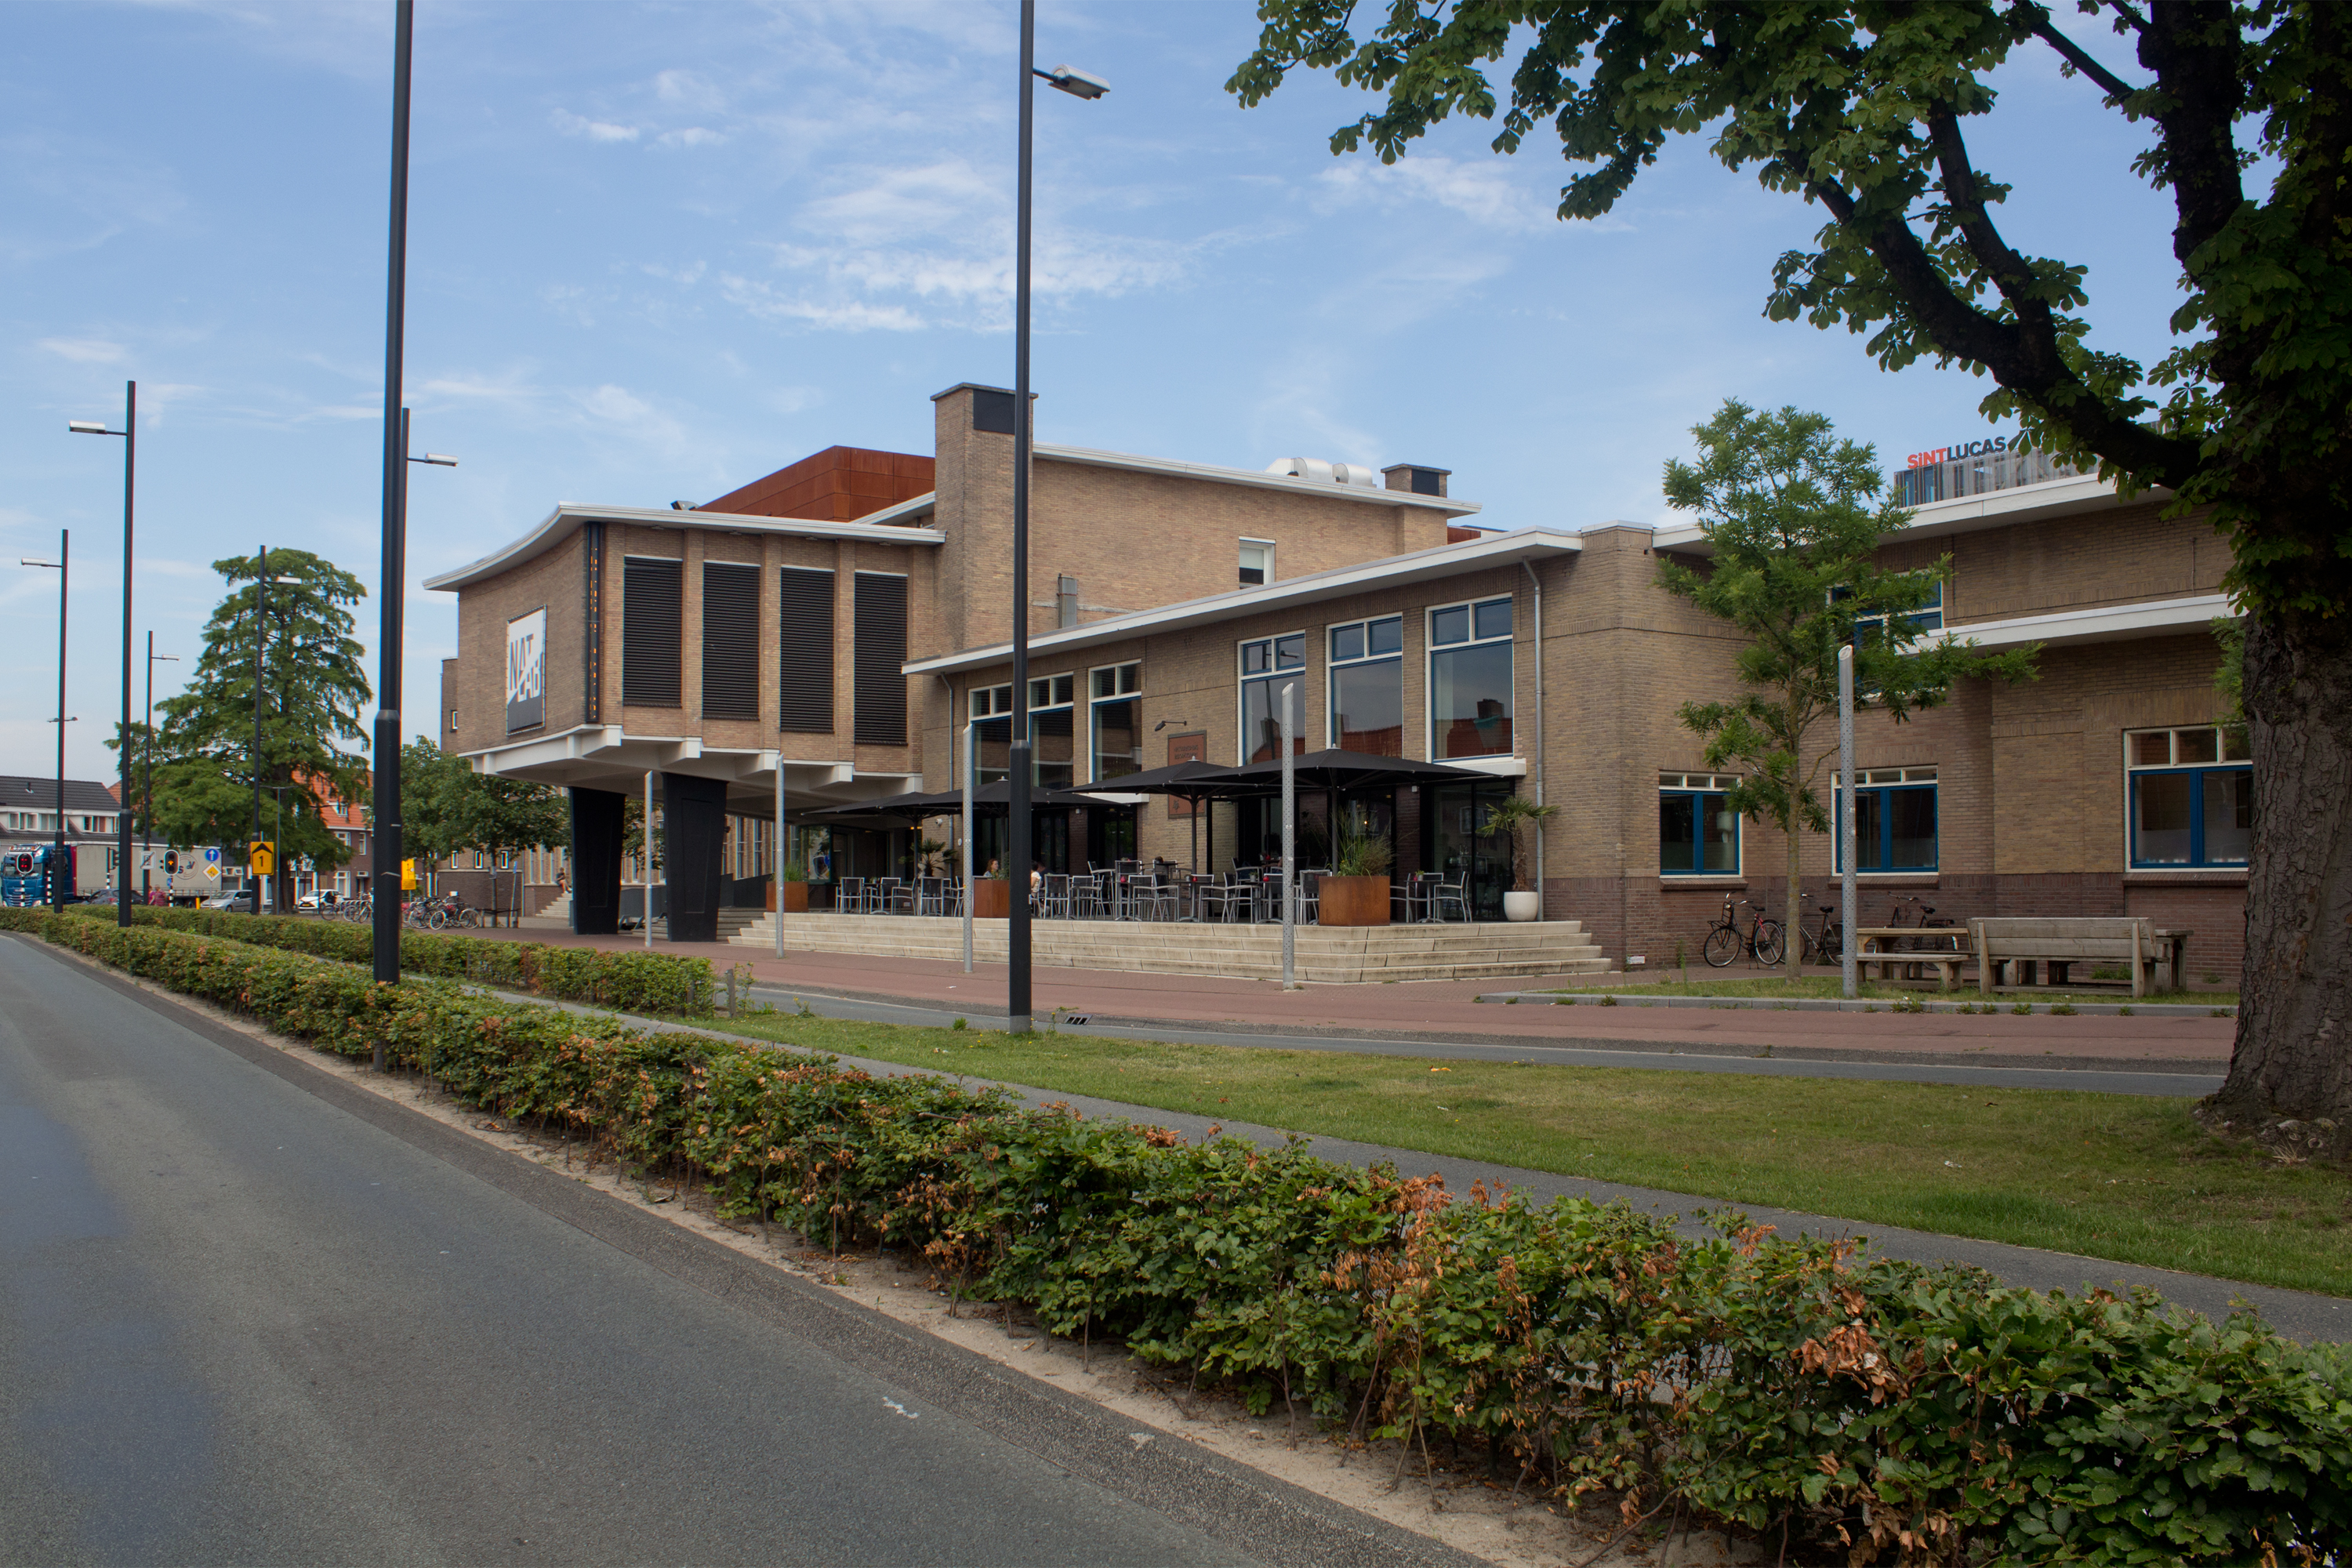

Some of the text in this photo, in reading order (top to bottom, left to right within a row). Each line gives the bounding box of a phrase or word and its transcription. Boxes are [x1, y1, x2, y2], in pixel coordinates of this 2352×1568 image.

[510, 633, 535, 691] NAT
[517, 656, 541, 702] LAB
[259, 855, 264, 867] 1
